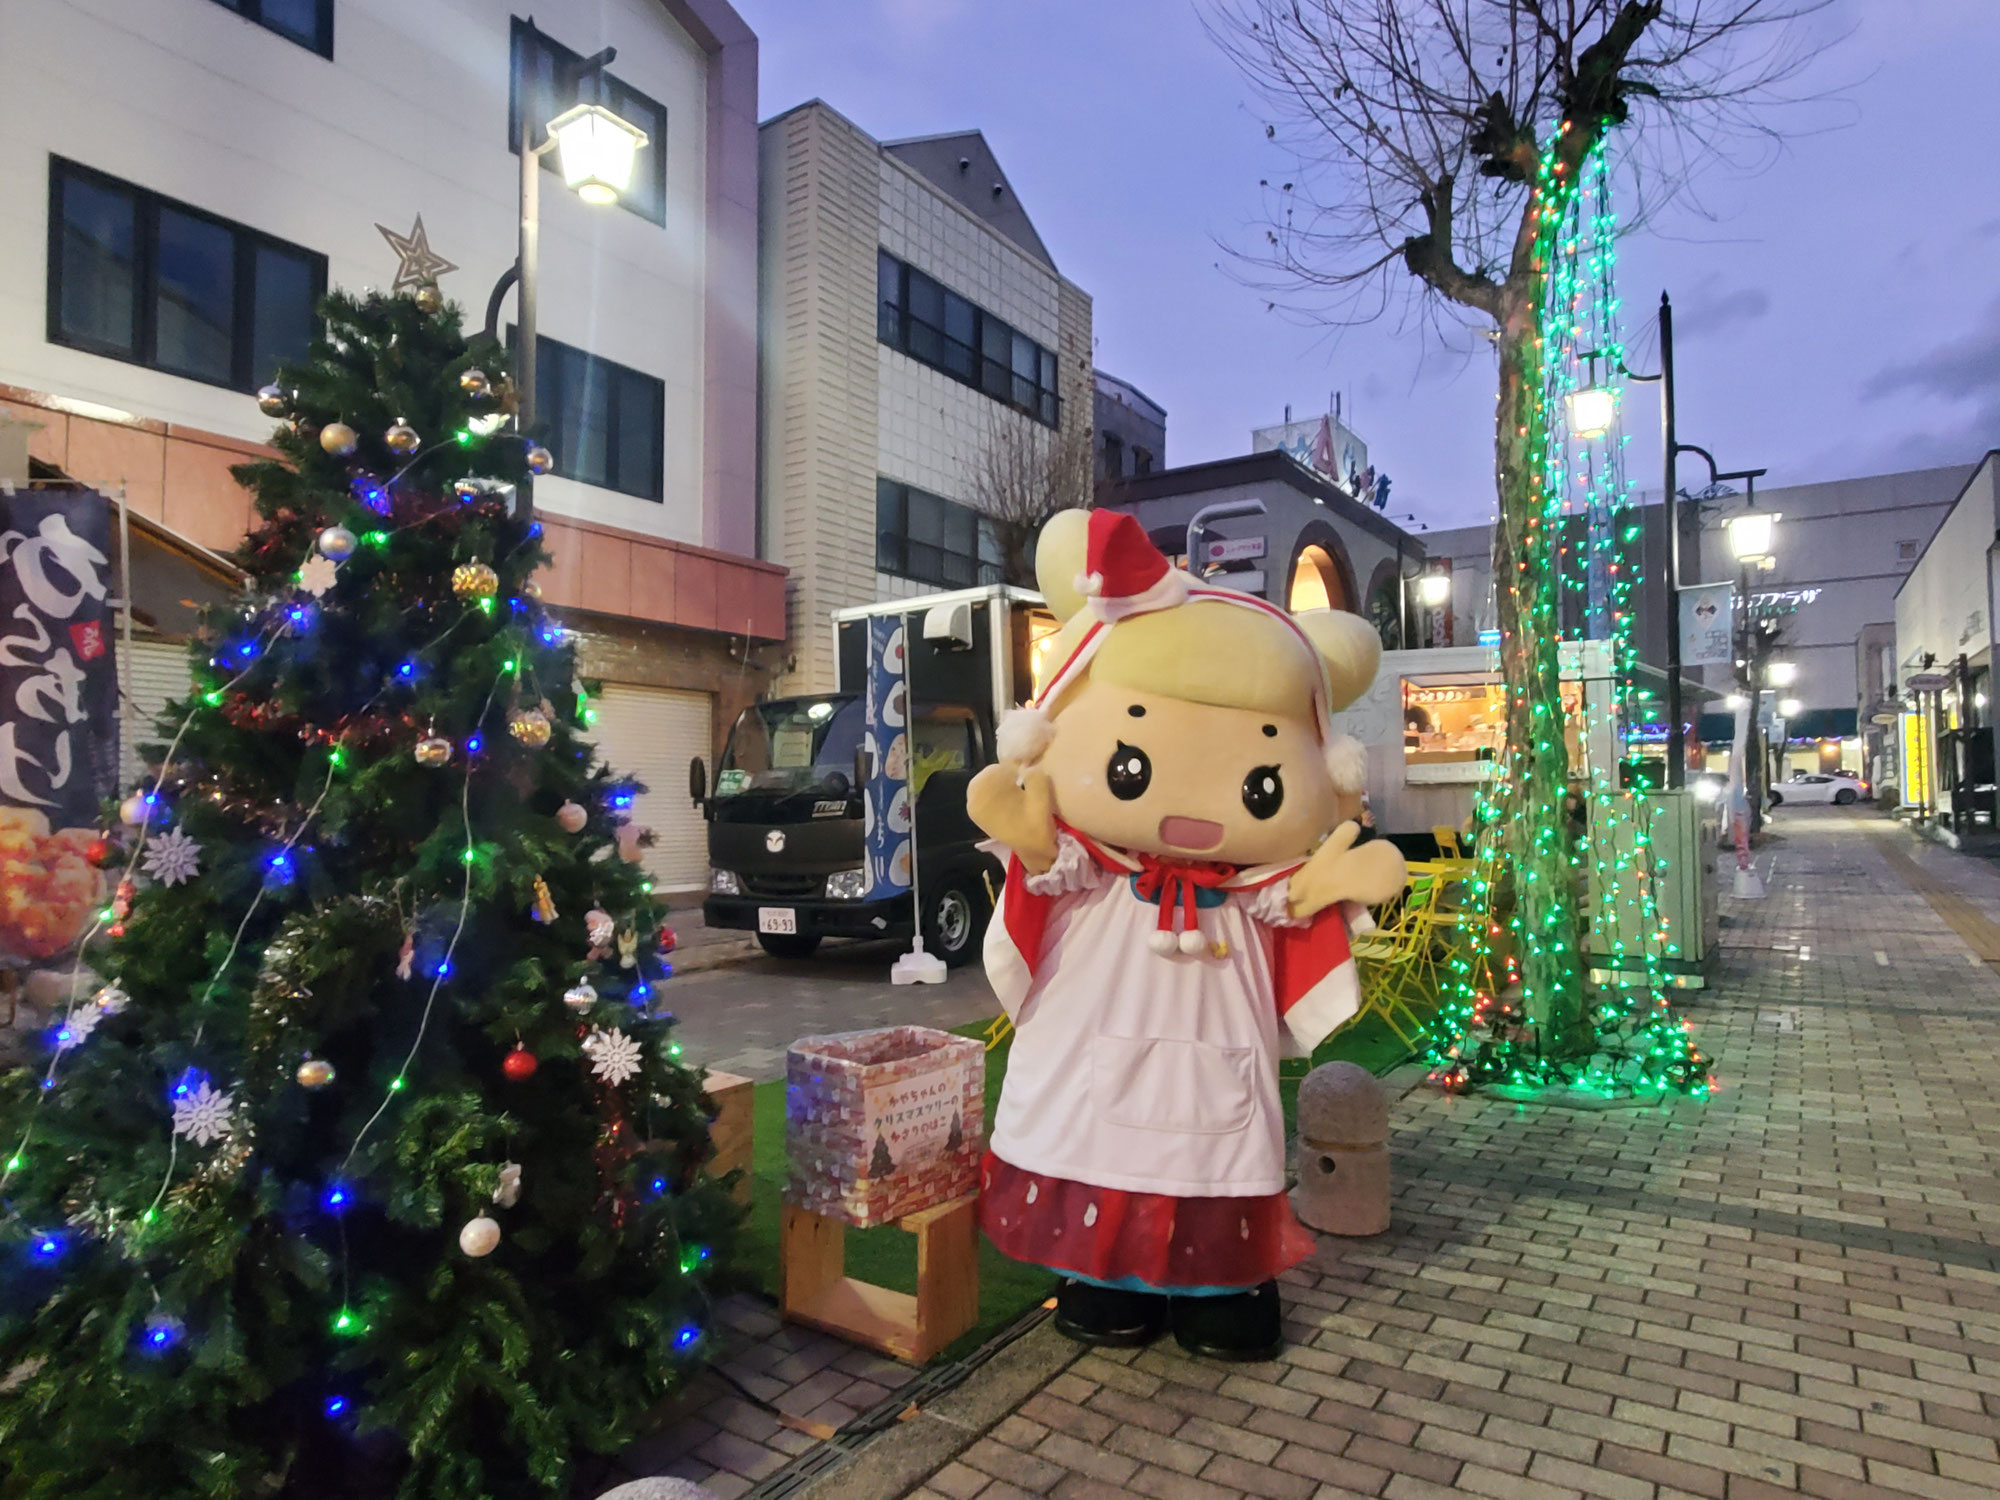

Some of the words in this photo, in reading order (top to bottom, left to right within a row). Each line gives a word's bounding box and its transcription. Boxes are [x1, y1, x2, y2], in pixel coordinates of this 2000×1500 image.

[874, 1095, 960, 1129] クリスマスツリーの
